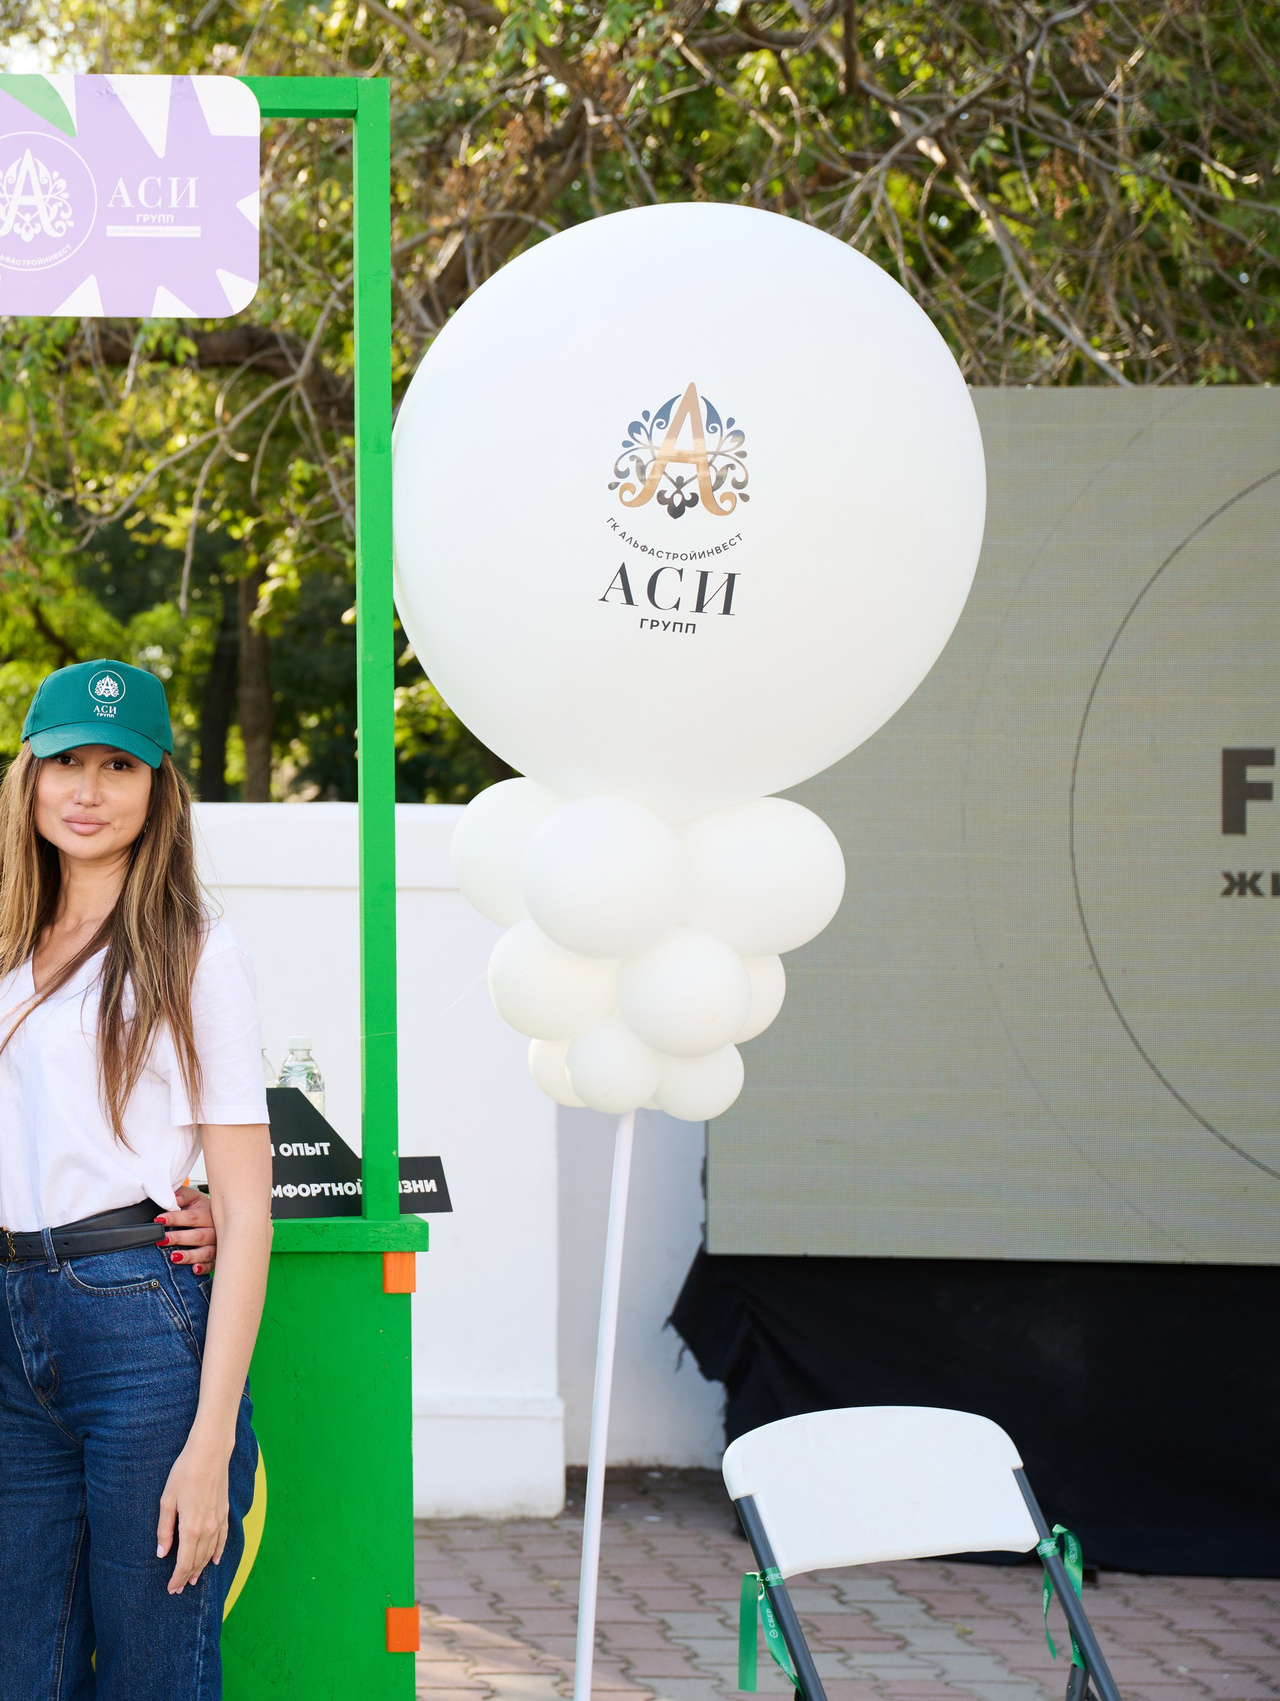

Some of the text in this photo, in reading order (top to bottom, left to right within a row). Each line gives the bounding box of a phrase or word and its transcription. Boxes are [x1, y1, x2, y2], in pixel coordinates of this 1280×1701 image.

[106, 176, 199, 208] АСИ
[136, 213, 174, 223] ГРУПП
[606, 517, 744, 562] ГК АЛЬФАСТРОЙИНВЕСТ
[597, 561, 742, 616] АСИ
[639, 618, 697, 635] ГРУПП
[93, 704, 117, 715] АСИ
[1221, 747, 1276, 836] F
[279, 1142, 331, 1157] ОПЫТ
[398, 1179, 438, 1194] ЗНИ
[765, 1608, 775, 1629] СБЕР
